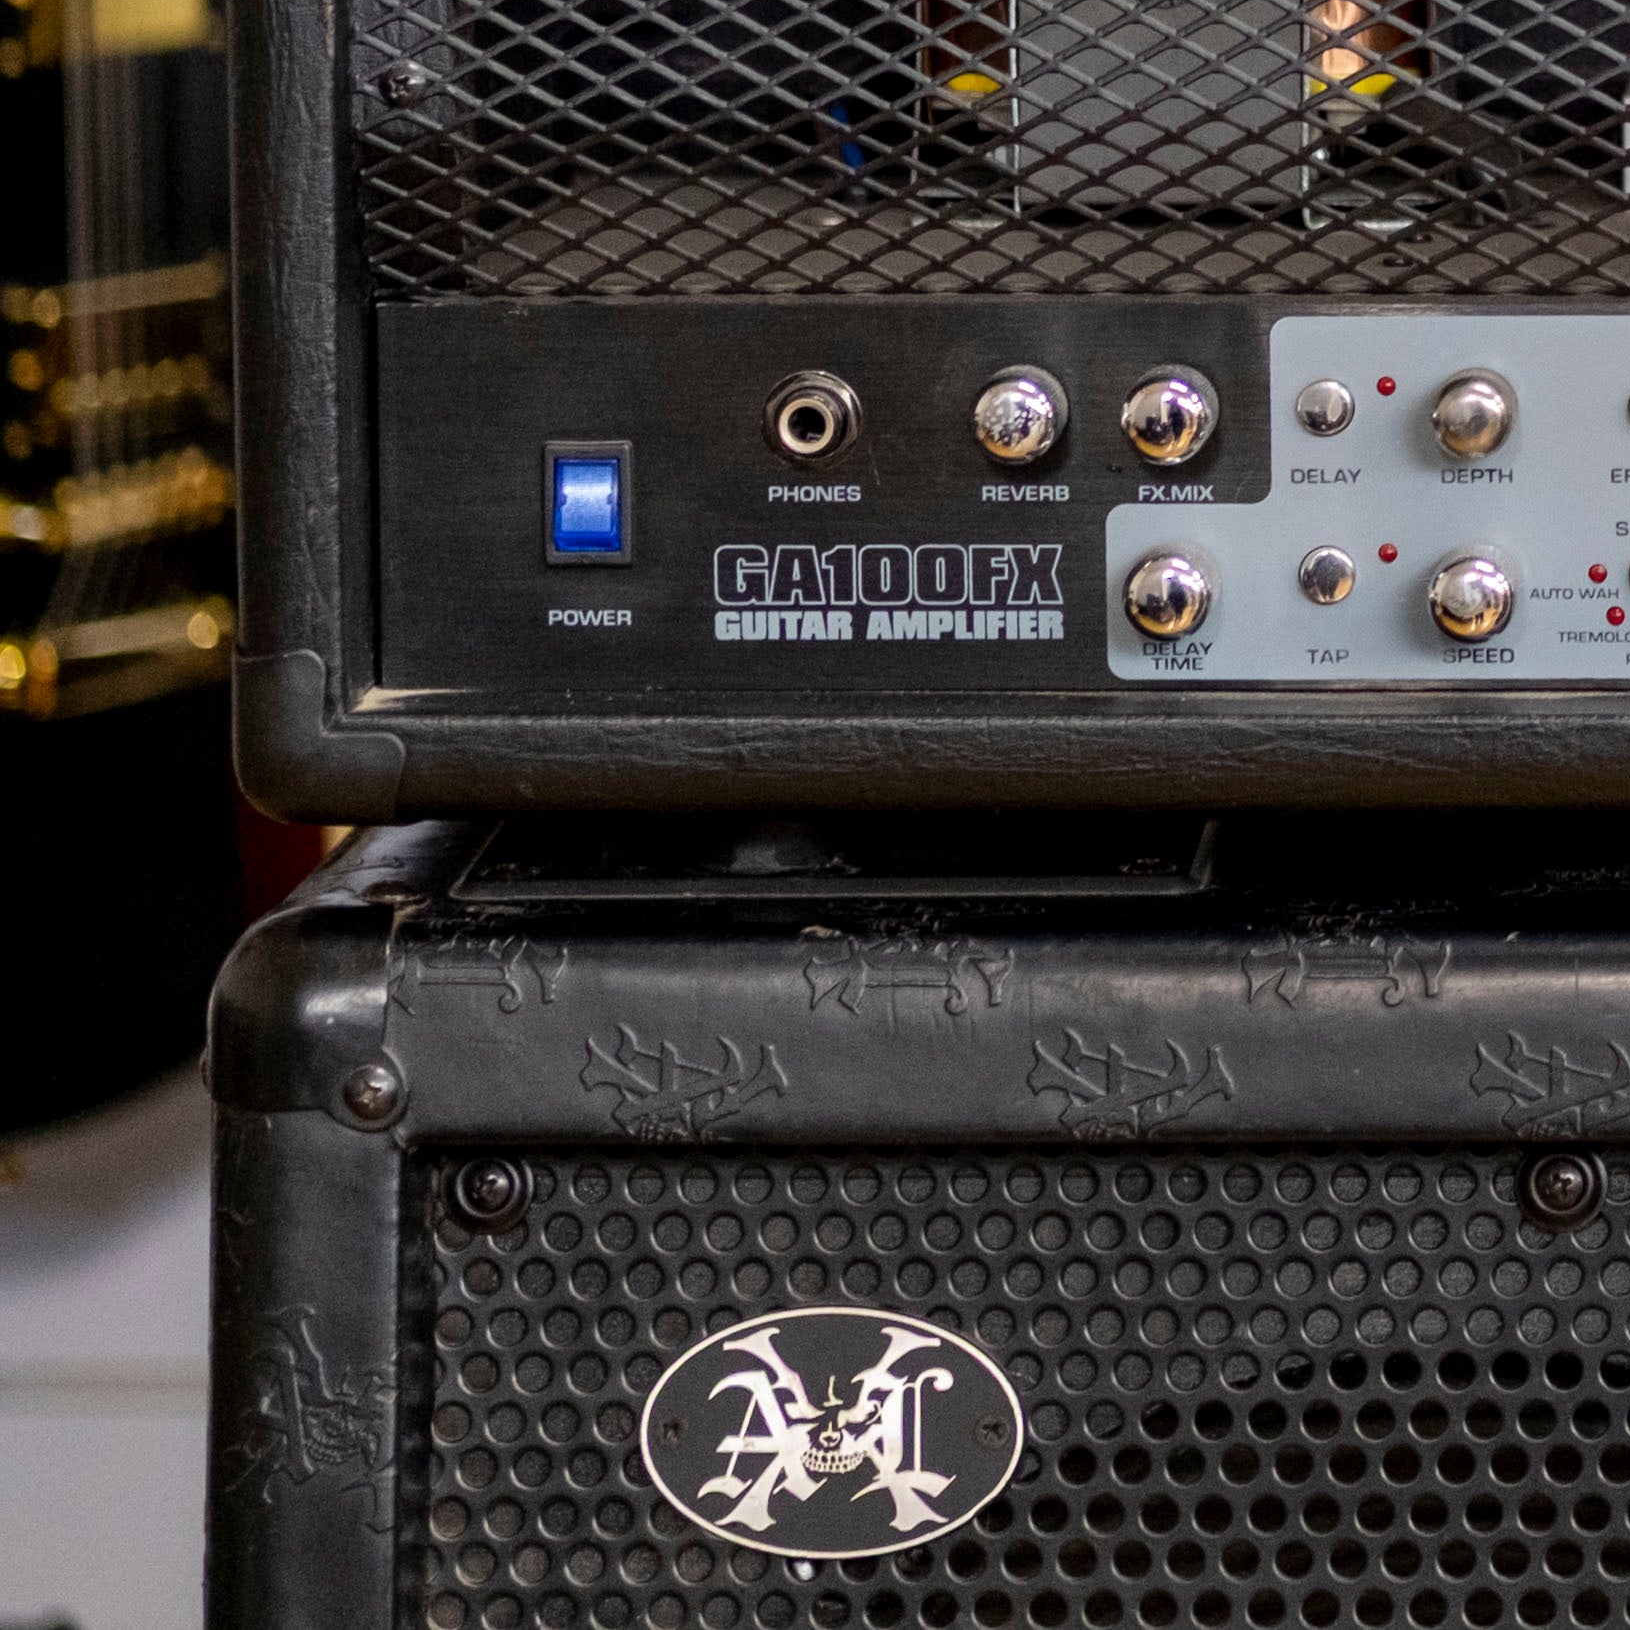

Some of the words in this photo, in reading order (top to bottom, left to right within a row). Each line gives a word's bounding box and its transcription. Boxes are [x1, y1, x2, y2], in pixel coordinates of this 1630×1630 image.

[1290, 468, 1361, 484] DELAY
[1441, 468, 1513, 484] DEPTH
[767, 484, 862, 502] PHONES
[981, 484, 1070, 502] REVERB
[1138, 485, 1214, 502] FX.MIX
[713, 544, 1064, 606] GA100FX
[1529, 587, 1574, 600] AUTO
[1579, 587, 1620, 600] WAH
[548, 609, 632, 627] POWER
[714, 611, 853, 641] GUITAR
[866, 610, 1064, 641] AMPLIFIER
[1142, 642, 1213, 657] DELAY
[1306, 648, 1350, 665] TAP
[1442, 648, 1515, 665] SPEED
[1152, 657, 1204, 671] TIME
